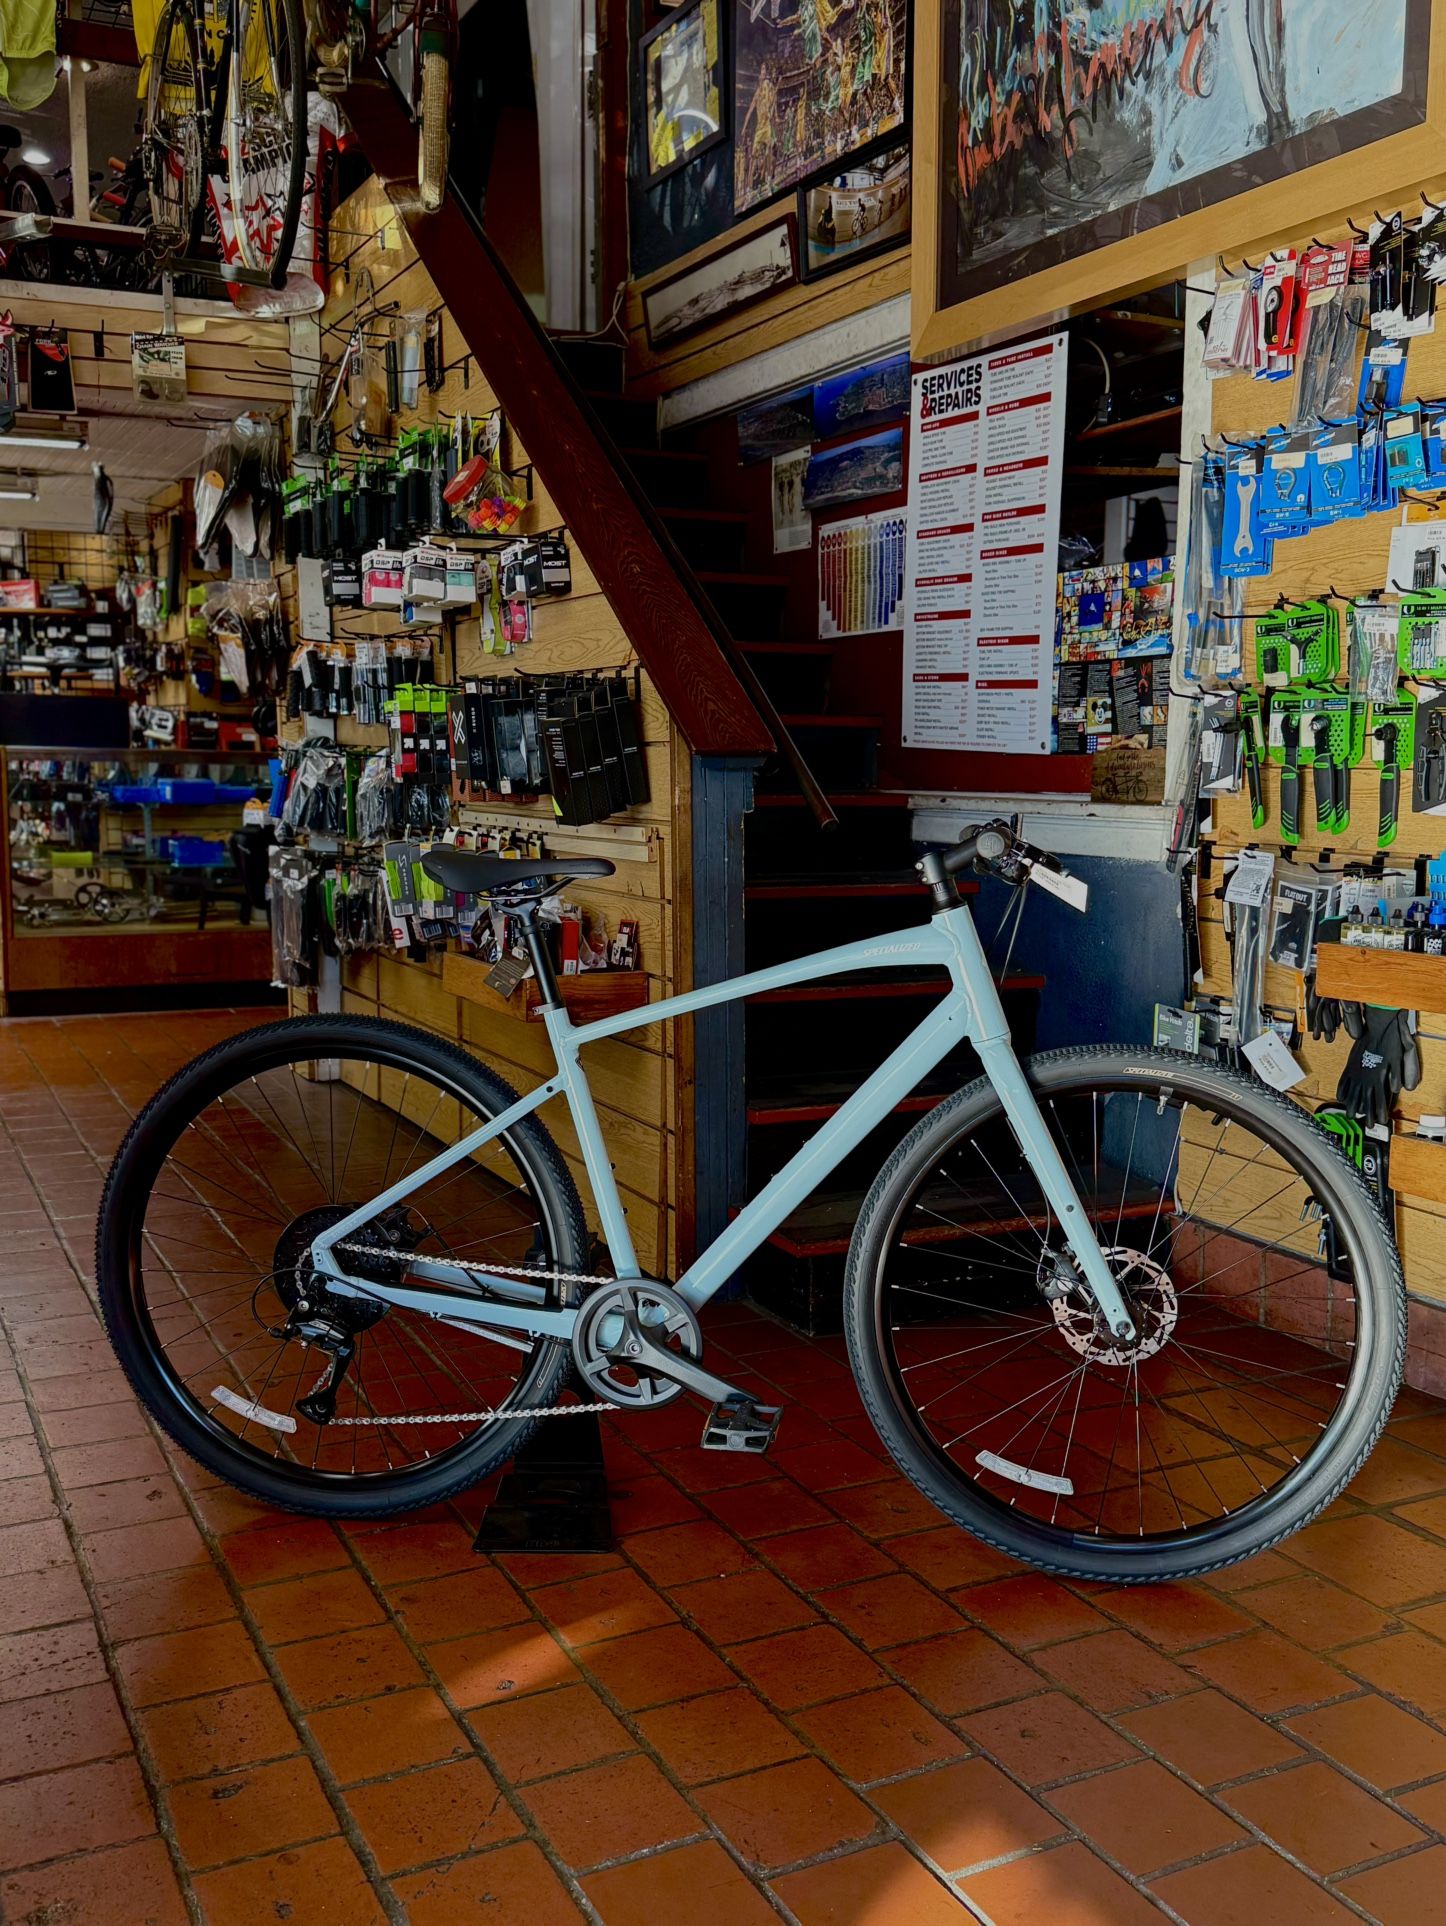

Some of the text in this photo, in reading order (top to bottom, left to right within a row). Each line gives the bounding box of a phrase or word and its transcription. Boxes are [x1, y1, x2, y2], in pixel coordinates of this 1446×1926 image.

[1331, 250, 1348, 262] TIRE
[1328, 262, 1347, 275] BEAD
[1327, 274, 1346, 286] JACK
[921, 362, 982, 394] SERVICES
[930, 385, 982, 416] REPAIRS
[863, 942, 921, 957] SPECIALIZED
